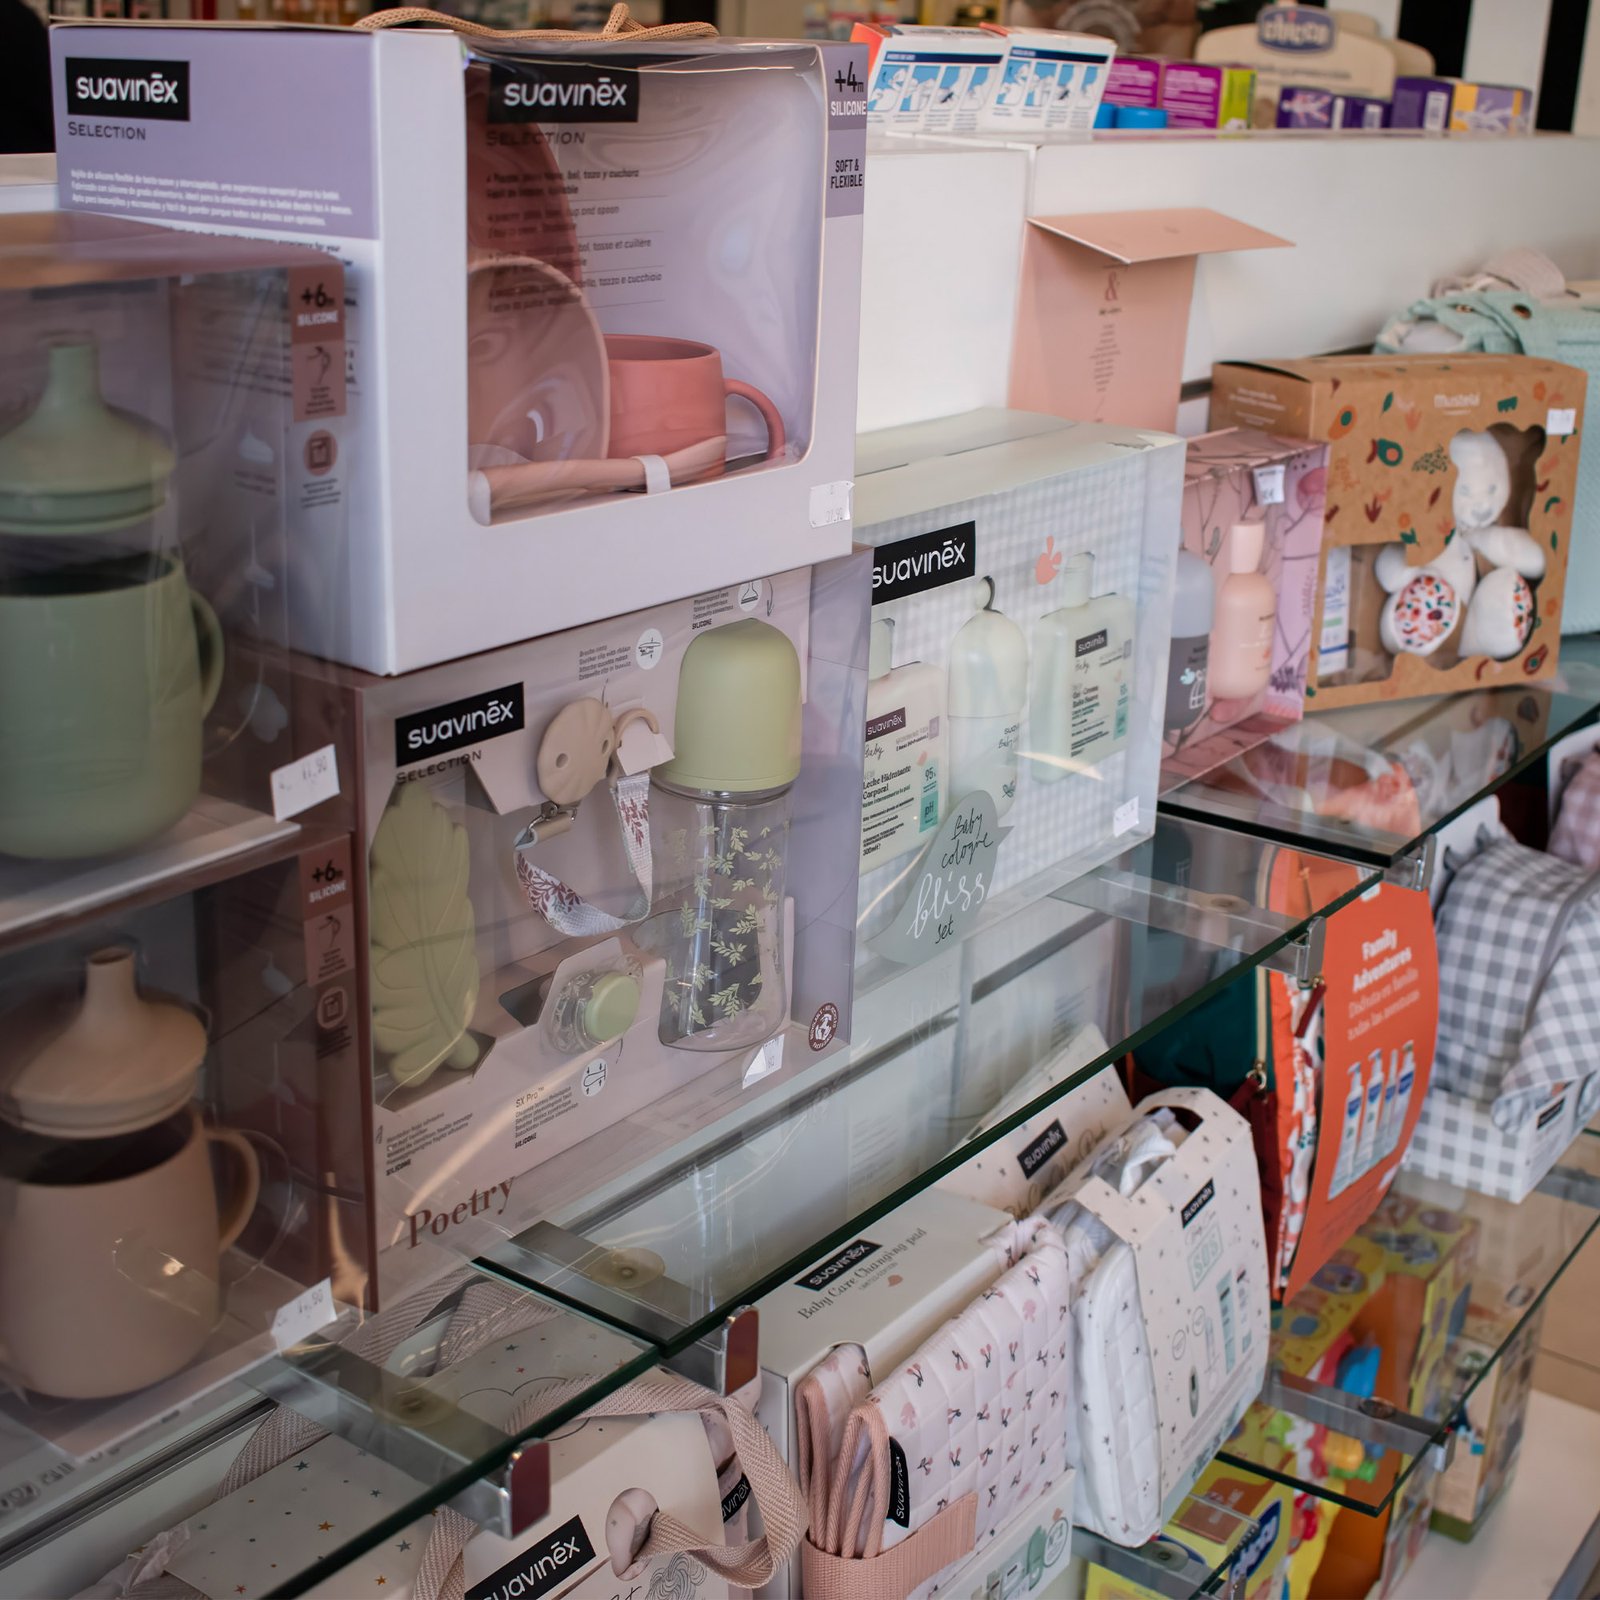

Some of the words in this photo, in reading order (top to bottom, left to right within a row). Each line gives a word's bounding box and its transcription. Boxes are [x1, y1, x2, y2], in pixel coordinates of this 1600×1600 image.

[830, 100, 867, 117] SILICONE
[830, 173, 863, 189] FLEXIBLE
[835, 159, 853, 173] SOFT
[854, 158, 860, 172] &
[924, 800, 934, 817] pH
[951, 807, 983, 841] Baby
[941, 831, 995, 869] cologne
[906, 870, 986, 940] bliss
[934, 913, 955, 945] set
[1361, 928, 1398, 962] Family
[1352, 946, 1413, 994] Adventures
[406, 1175, 517, 1250] Poetry
[797, 1296, 834, 1320] Baby
[827, 1276, 856, 1298] Care
[854, 1243, 908, 1280] Changing
[905, 1226, 929, 1246] pad
